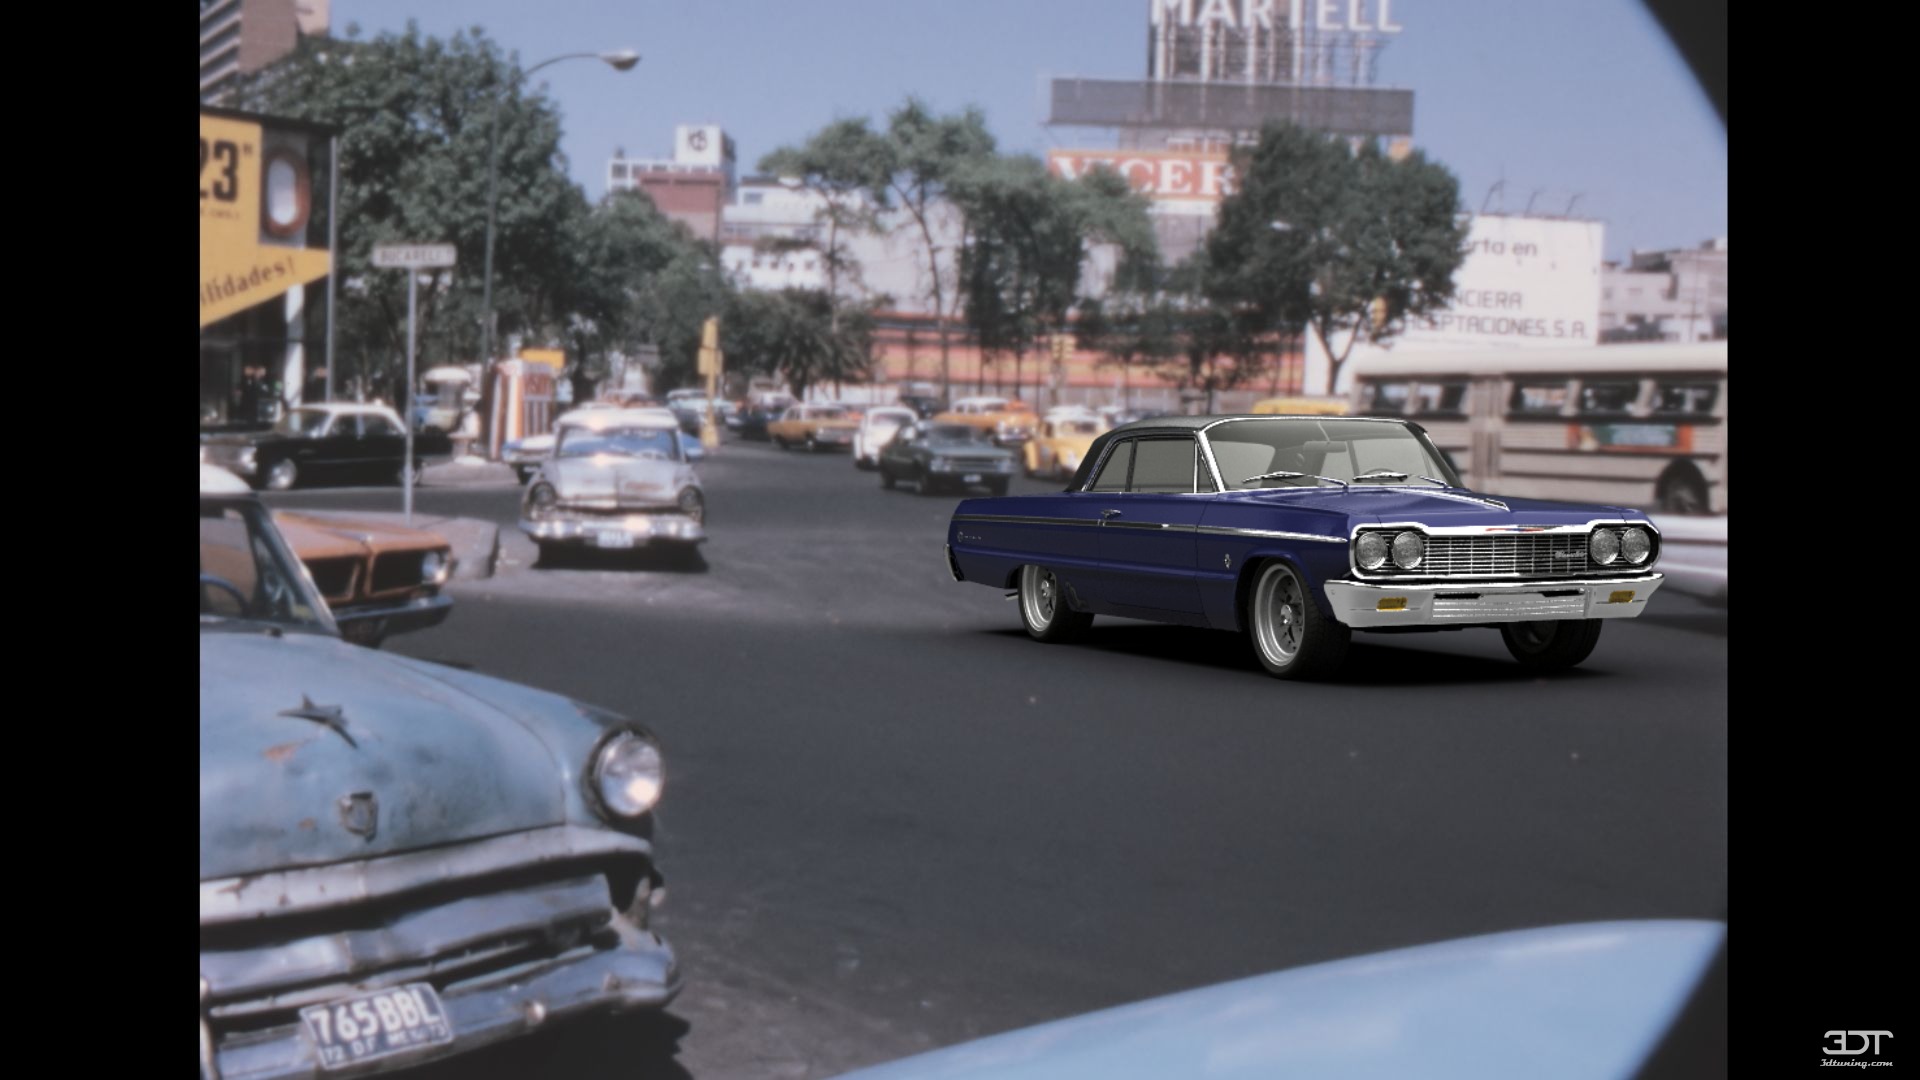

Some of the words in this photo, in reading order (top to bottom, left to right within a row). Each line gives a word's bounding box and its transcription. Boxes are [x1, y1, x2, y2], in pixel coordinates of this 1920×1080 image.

[1149, 0, 1403, 32] MARTELL
[1053, 157, 1240, 195] VCER
[1512, 242, 1538, 256] en
[309, 989, 440, 1045] 765BBL
